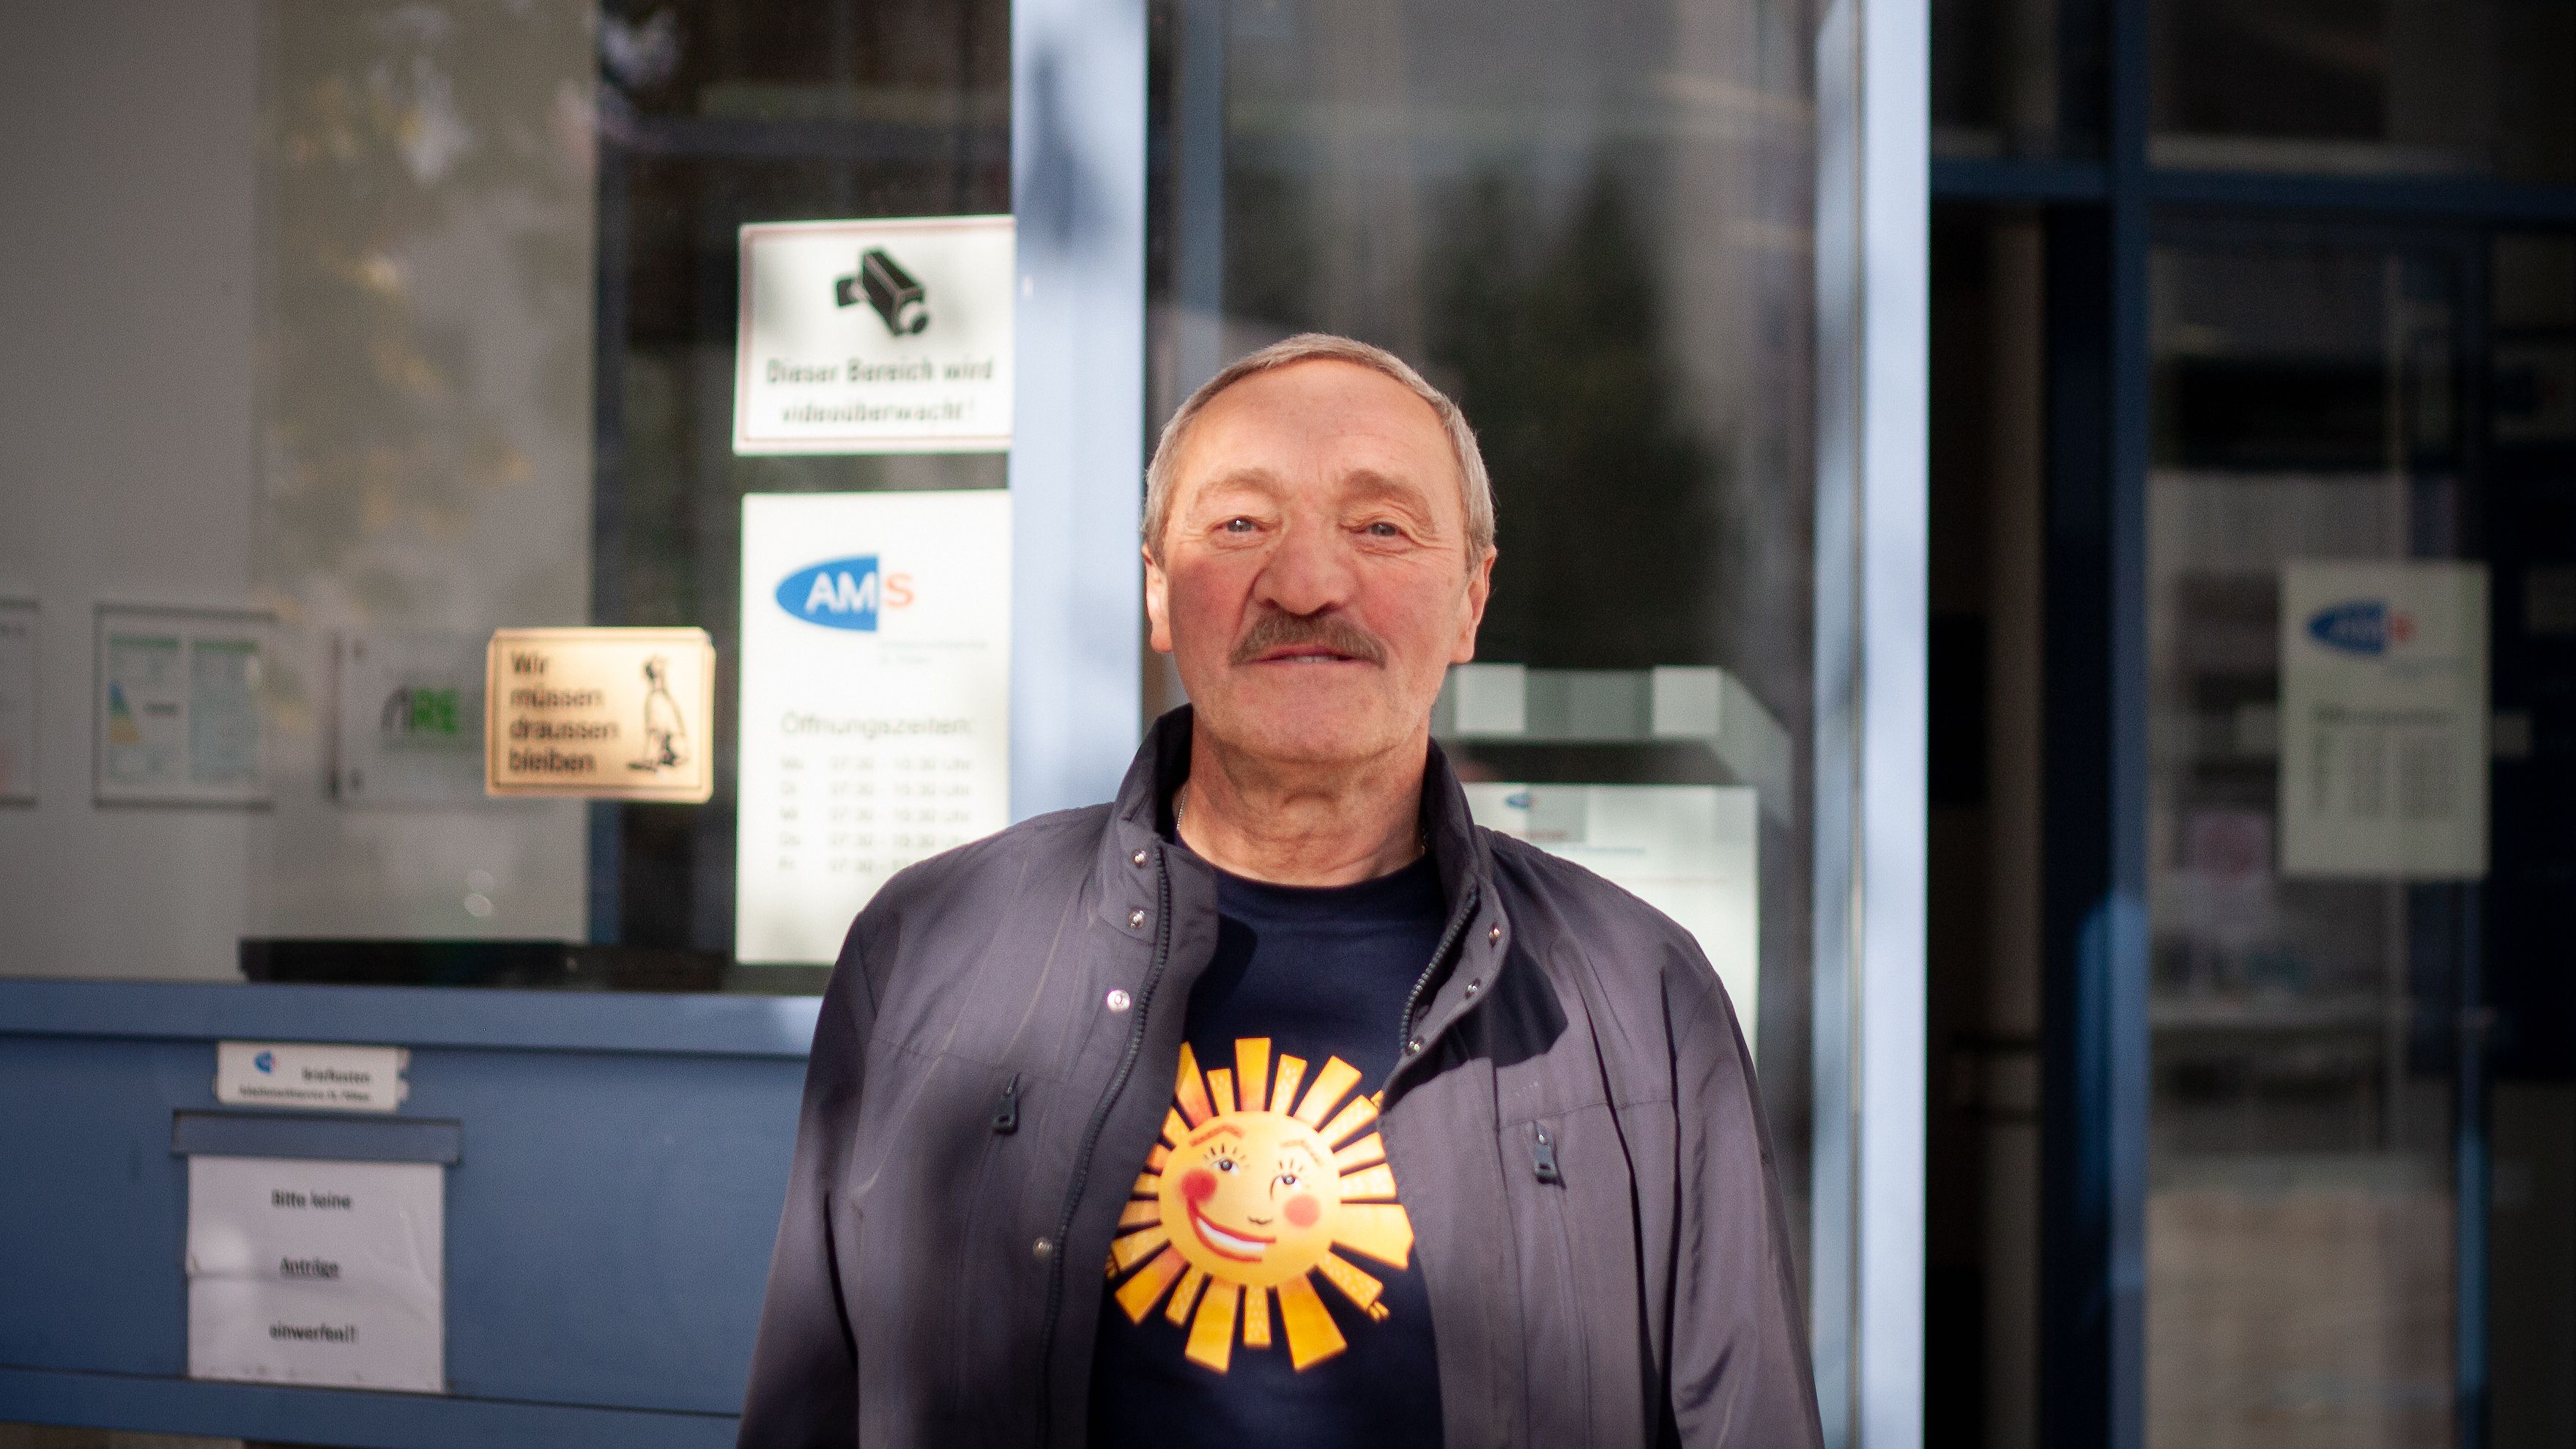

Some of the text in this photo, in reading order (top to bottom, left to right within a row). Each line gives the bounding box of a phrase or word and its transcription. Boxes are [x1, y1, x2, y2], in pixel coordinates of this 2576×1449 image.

[767, 357, 995, 384] Dieser Bereich wird
[806, 571, 914, 614] AMS
[511, 653, 546, 674] Wir
[511, 685, 602, 706] müssen
[511, 717, 619, 740] draussen
[510, 747, 597, 771] bleiben
[271, 1189, 352, 1209] Bitte keine
[281, 1256, 340, 1278] Anträge
